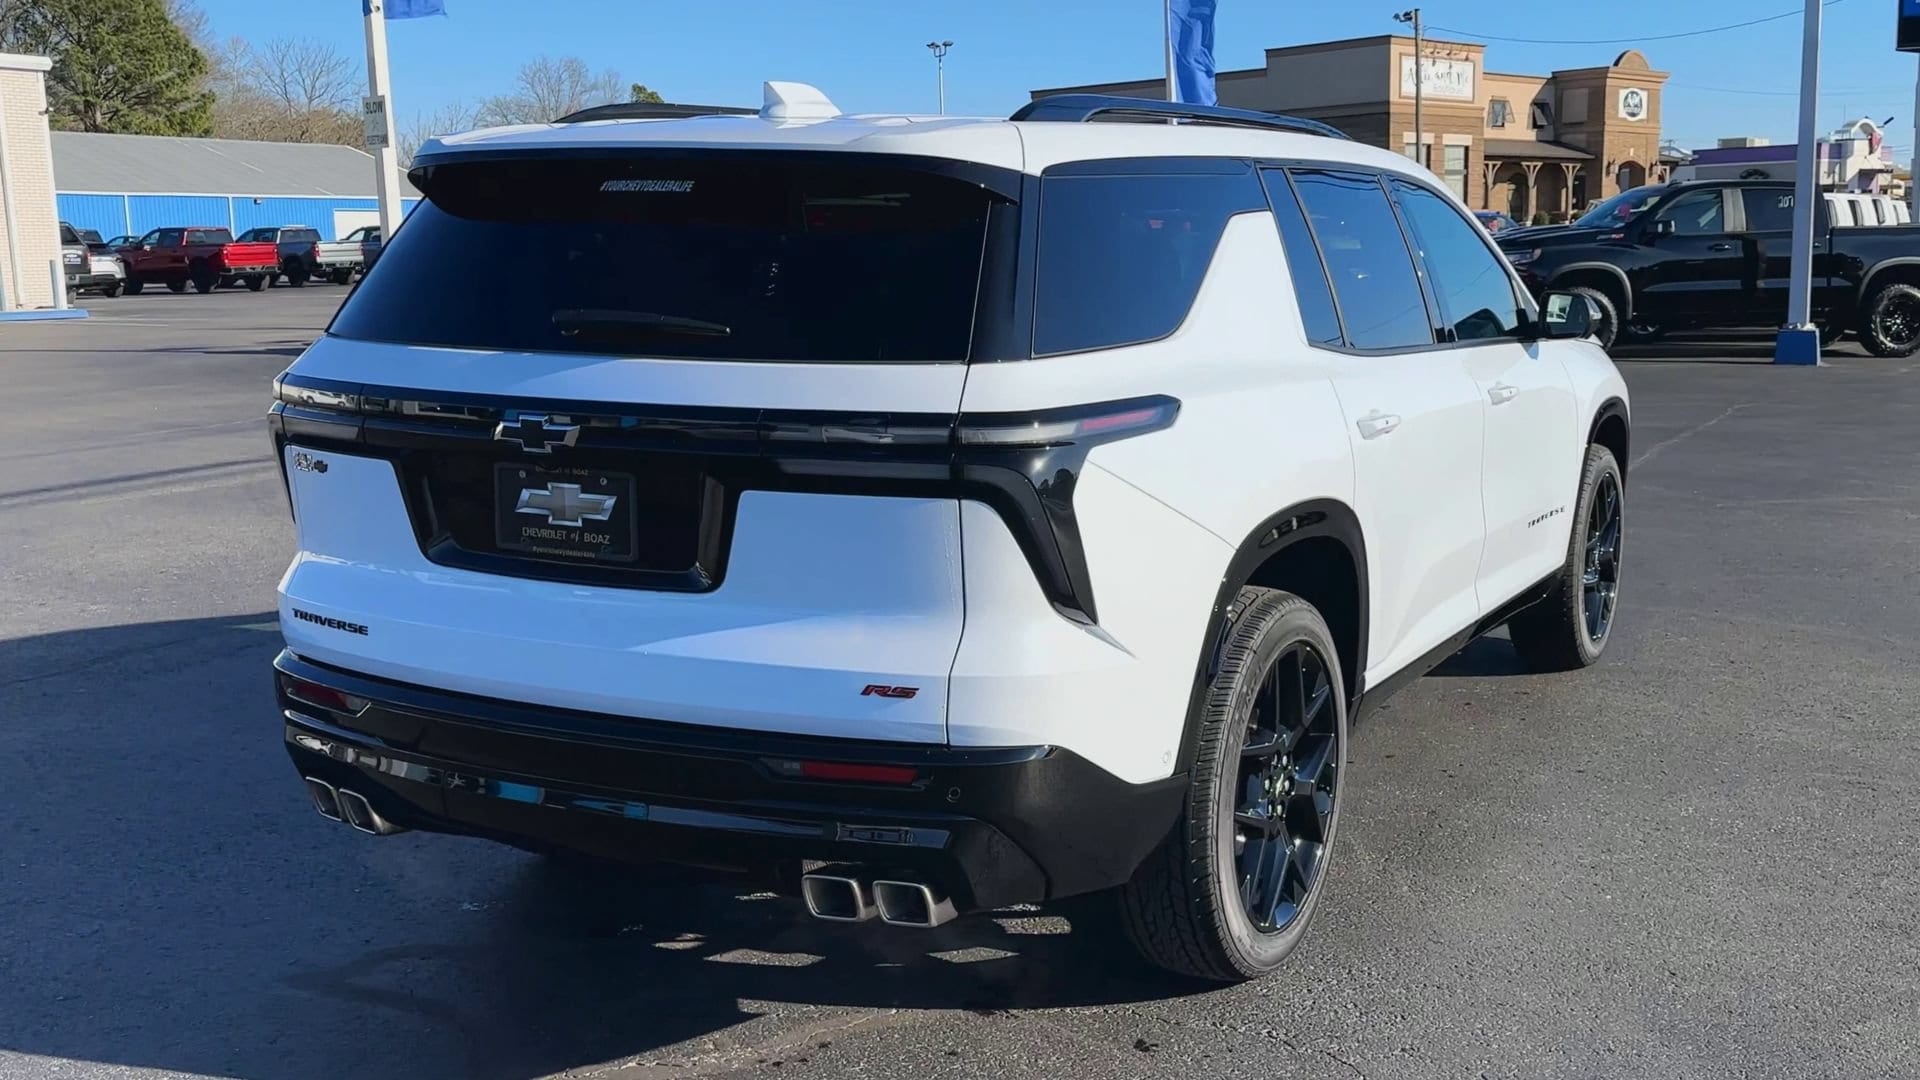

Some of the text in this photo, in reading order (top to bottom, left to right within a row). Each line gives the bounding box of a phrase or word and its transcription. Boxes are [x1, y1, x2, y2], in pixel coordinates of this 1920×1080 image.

[365, 101, 383, 114] SLOW
[522, 526, 567, 540] CHEVROLET
[584, 532, 611, 545] BOAZ
[292, 608, 368, 636] TRAVERSE
[860, 684, 919, 699] RS
